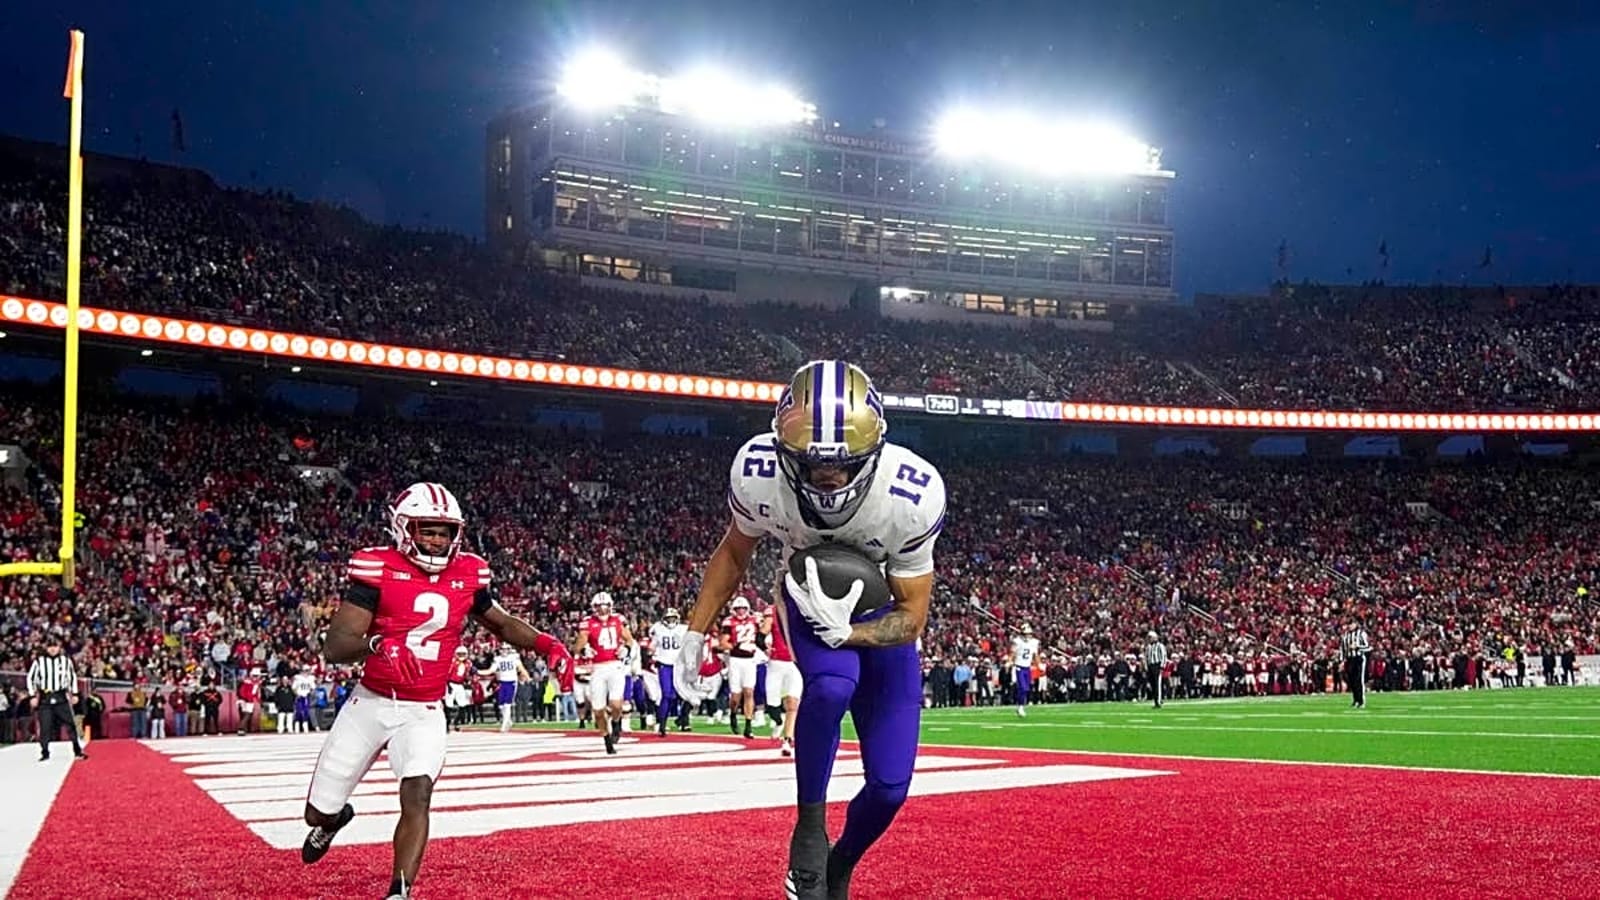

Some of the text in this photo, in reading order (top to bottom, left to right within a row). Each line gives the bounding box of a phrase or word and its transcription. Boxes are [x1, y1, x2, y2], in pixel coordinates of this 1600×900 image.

[743, 443, 777, 479] 12
[888, 463, 931, 506] 12
[759, 503, 769, 517] C
[405, 591, 449, 662] 2
[597, 626, 618, 650] 41
[1022, 648, 1031, 660] 2
